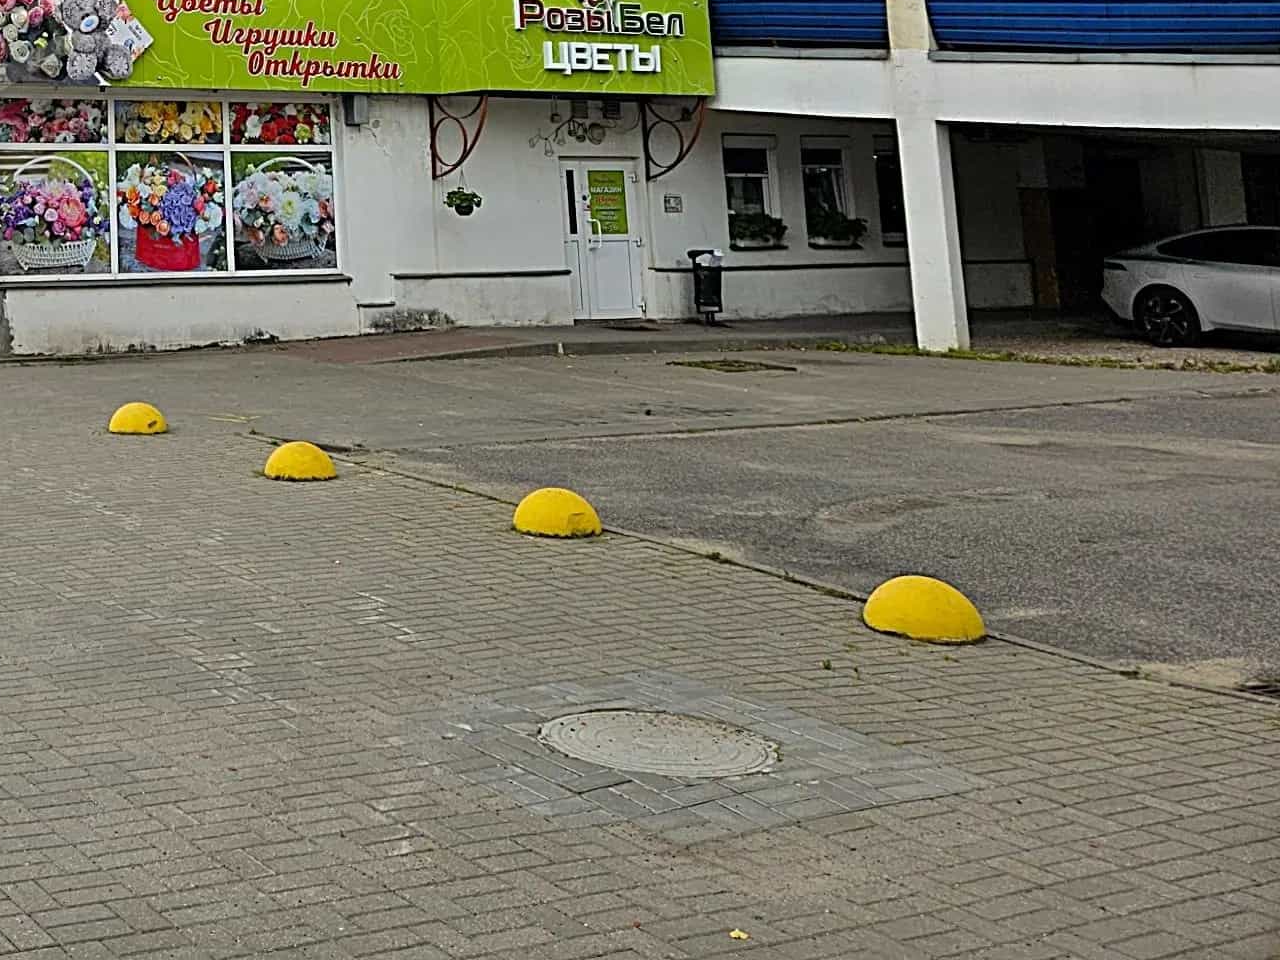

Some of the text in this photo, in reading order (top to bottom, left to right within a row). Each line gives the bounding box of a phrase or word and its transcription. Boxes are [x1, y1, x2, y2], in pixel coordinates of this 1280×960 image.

[204, 18, 337, 57] Игрушки
[247, 50, 402, 88] Открытки
[543, 41, 661, 75] ЦВЕТЫ
